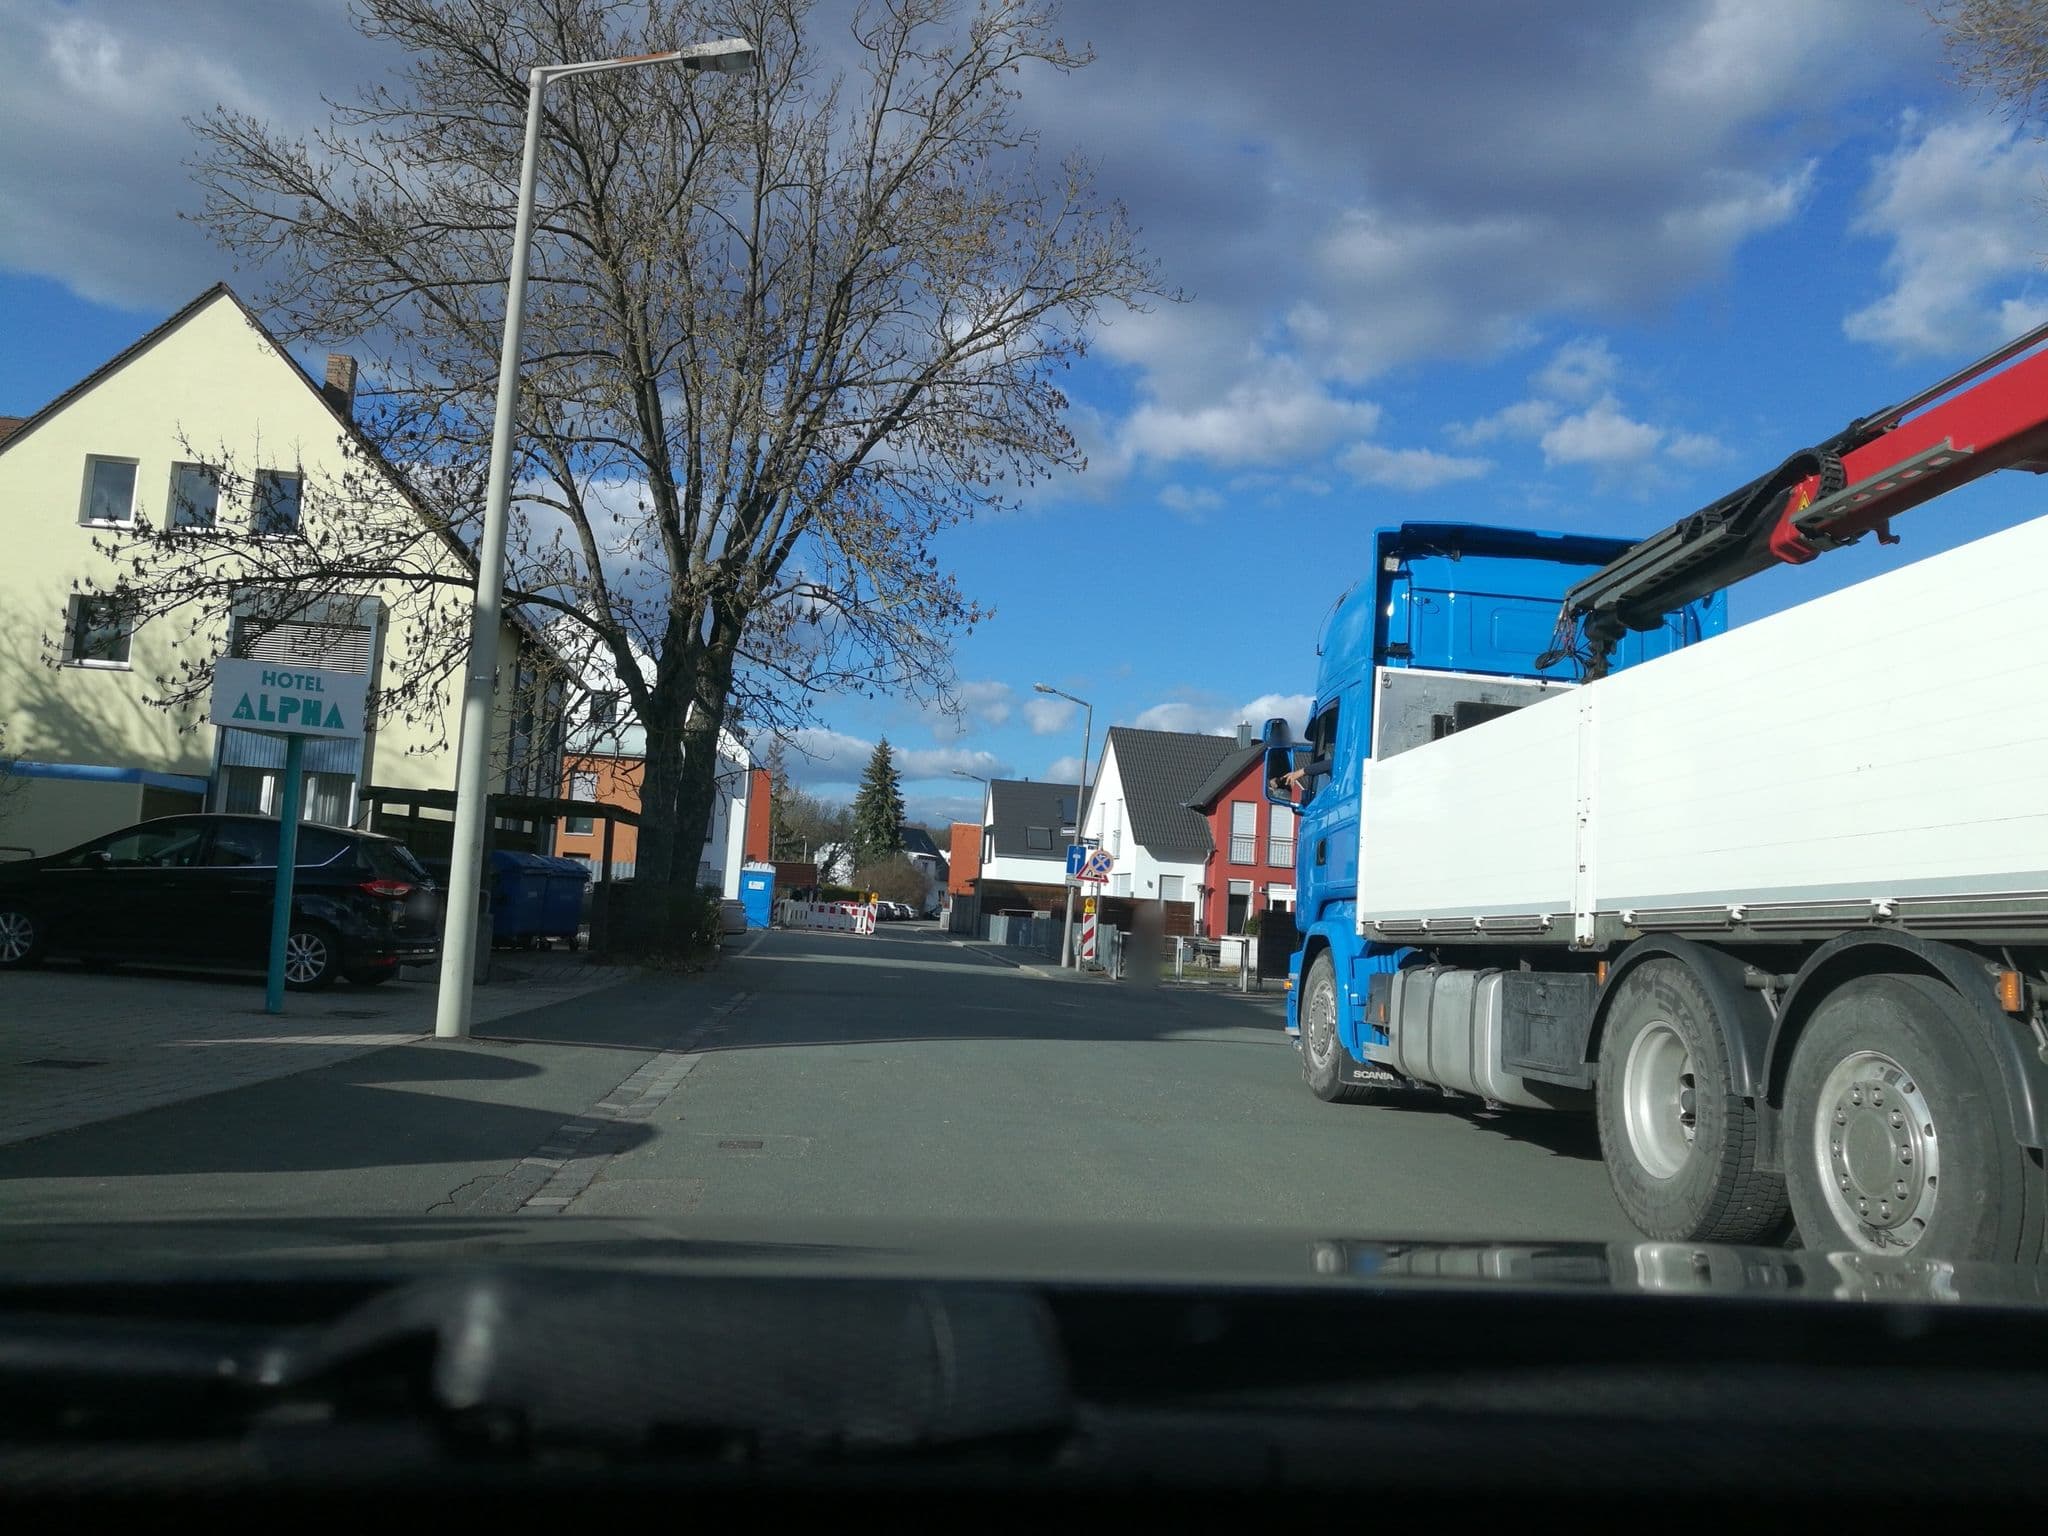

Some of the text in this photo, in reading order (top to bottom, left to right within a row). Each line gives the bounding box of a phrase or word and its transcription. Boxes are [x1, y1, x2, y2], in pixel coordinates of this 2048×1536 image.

[262, 670, 325, 692] HOTEL
[231, 691, 345, 729] ALPHA
[1353, 1070, 1394, 1081] SCANIA
